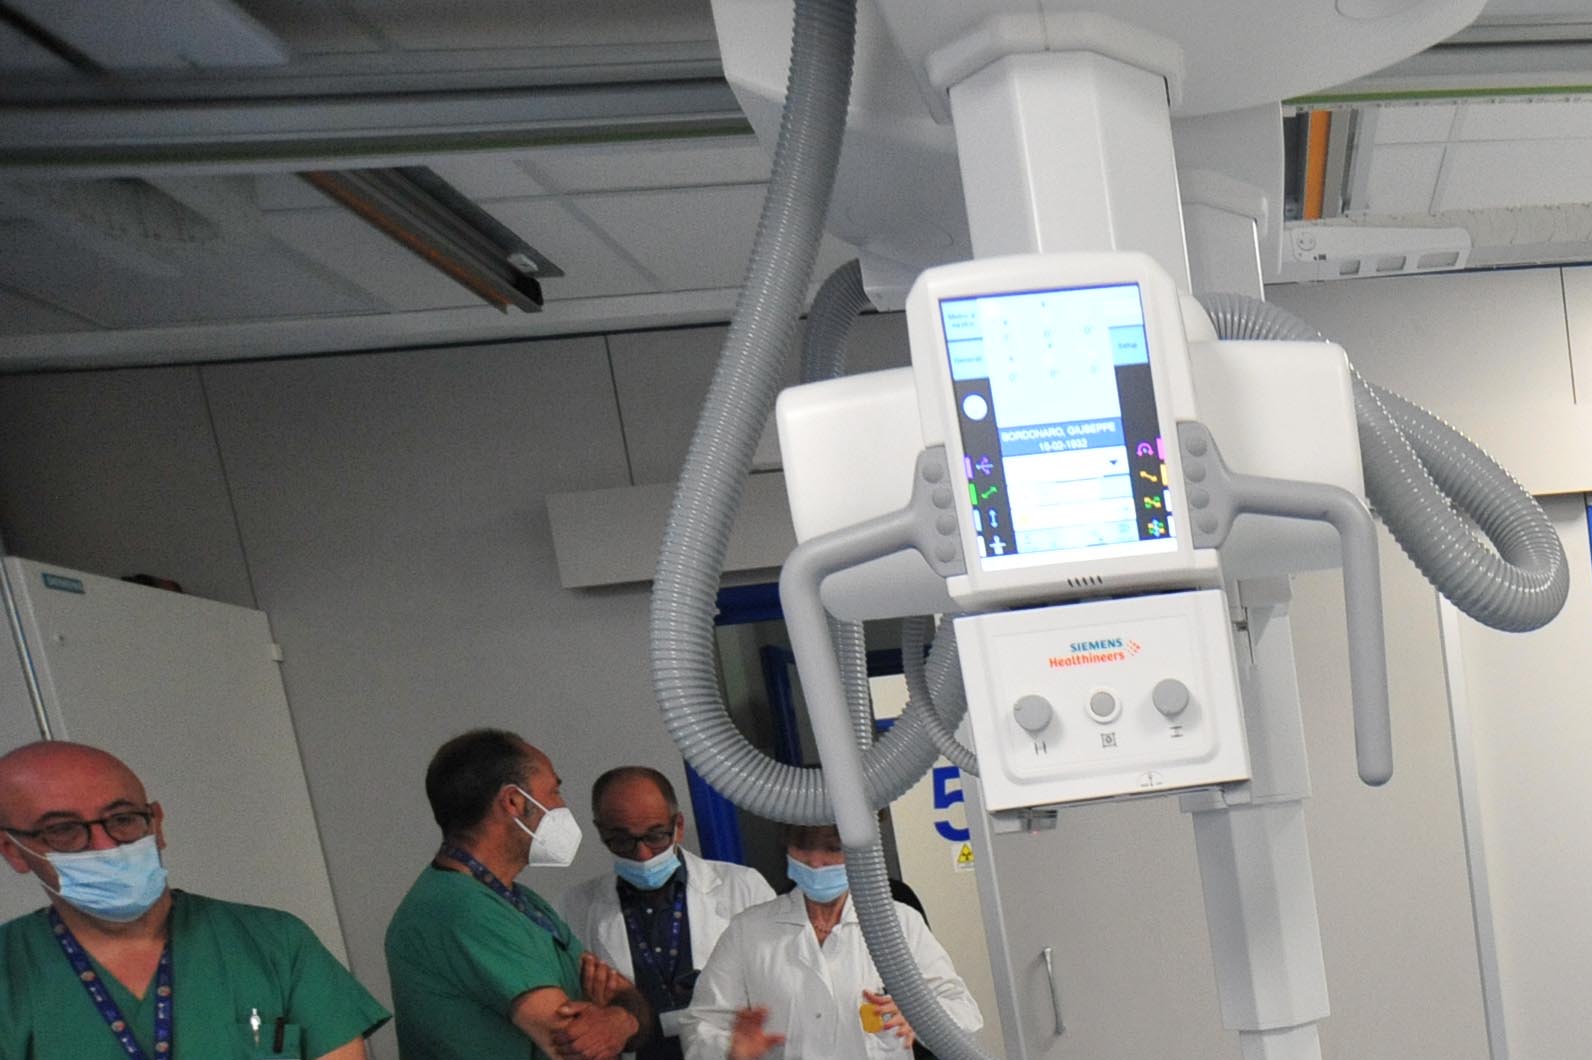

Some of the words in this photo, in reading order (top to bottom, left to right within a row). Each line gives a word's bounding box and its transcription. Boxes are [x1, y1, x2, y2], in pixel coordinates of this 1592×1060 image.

[1070, 638, 1123, 653] SIEMENS
[1049, 651, 1125, 668] Healthineers
[933, 766, 971, 842] 5
